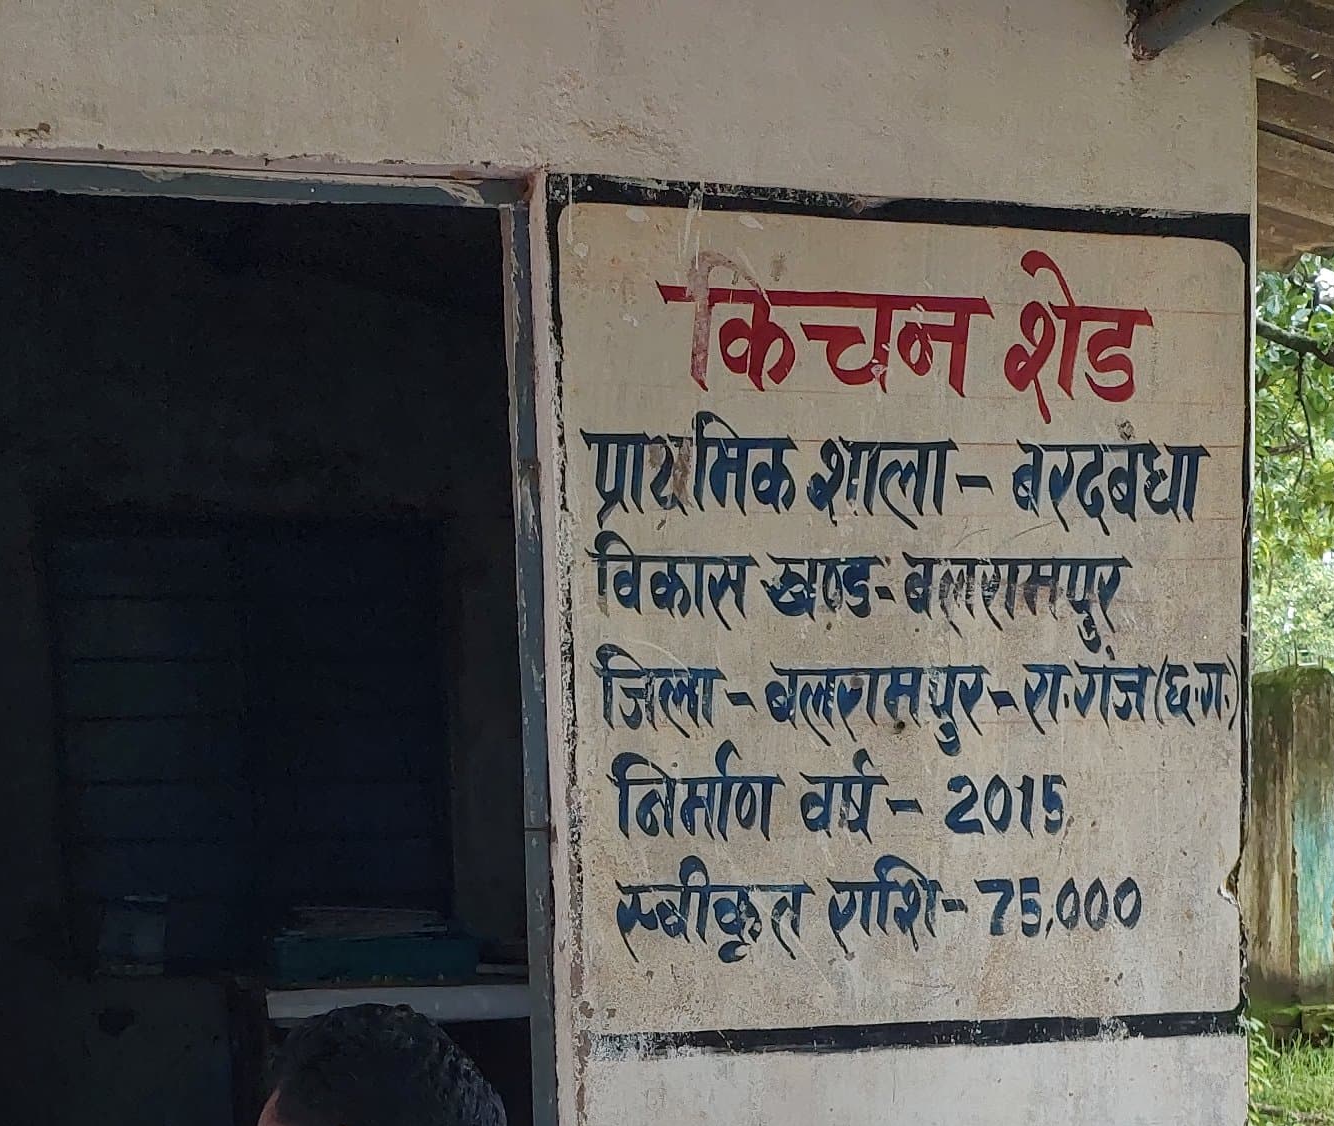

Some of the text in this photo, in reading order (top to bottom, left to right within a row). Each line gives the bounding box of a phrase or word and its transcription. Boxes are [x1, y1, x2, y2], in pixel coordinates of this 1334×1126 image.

[655, 247, 1154, 424] किचन शेड
[580, 411, 798, 530] प्राथमिक
[584, 530, 760, 631] विकास
[606, 739, 786, 842] निर्माण
[945, 772, 1067, 840] 2015
